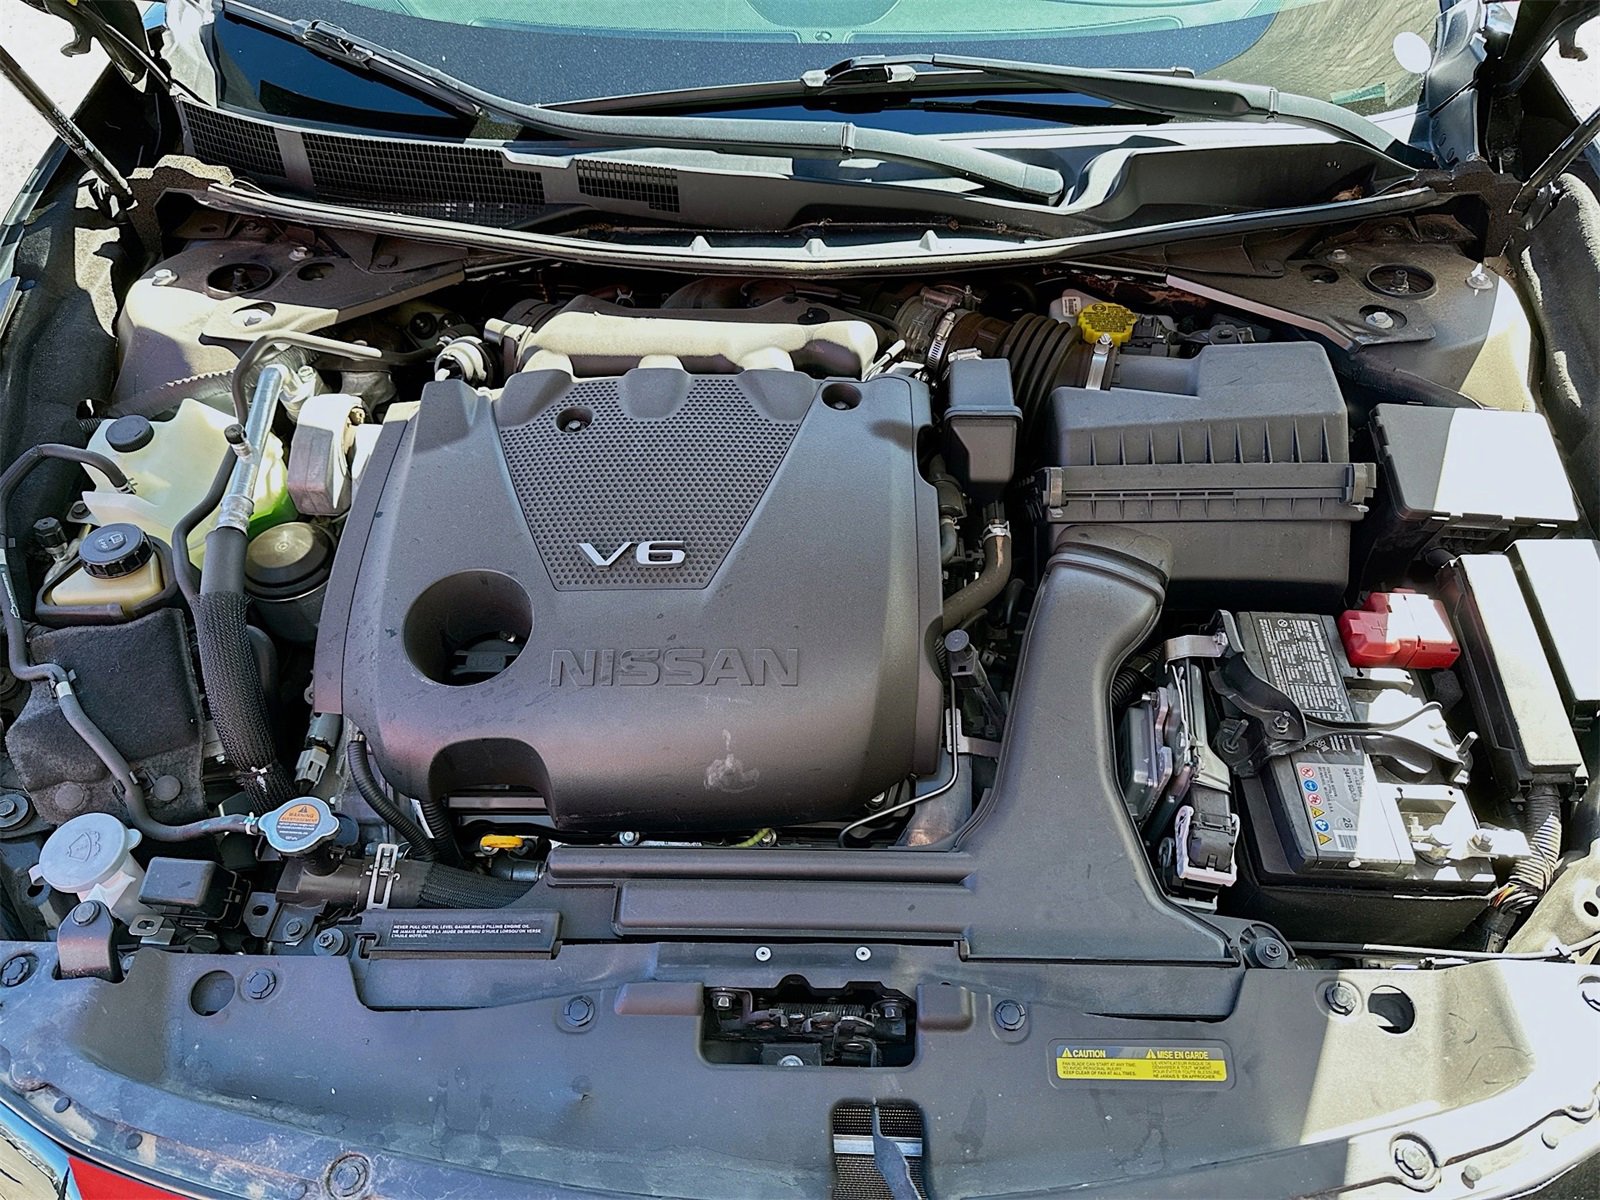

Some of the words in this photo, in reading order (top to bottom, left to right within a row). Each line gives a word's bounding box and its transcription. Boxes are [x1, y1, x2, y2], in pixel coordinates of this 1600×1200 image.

[578, 540, 687, 568] V6
[550, 647, 800, 688] NISSAN
[1072, 1049, 1106, 1058] CAUTION
[1157, 1050, 1173, 1058] MISE
[1185, 1051, 1209, 1060] GARDE
